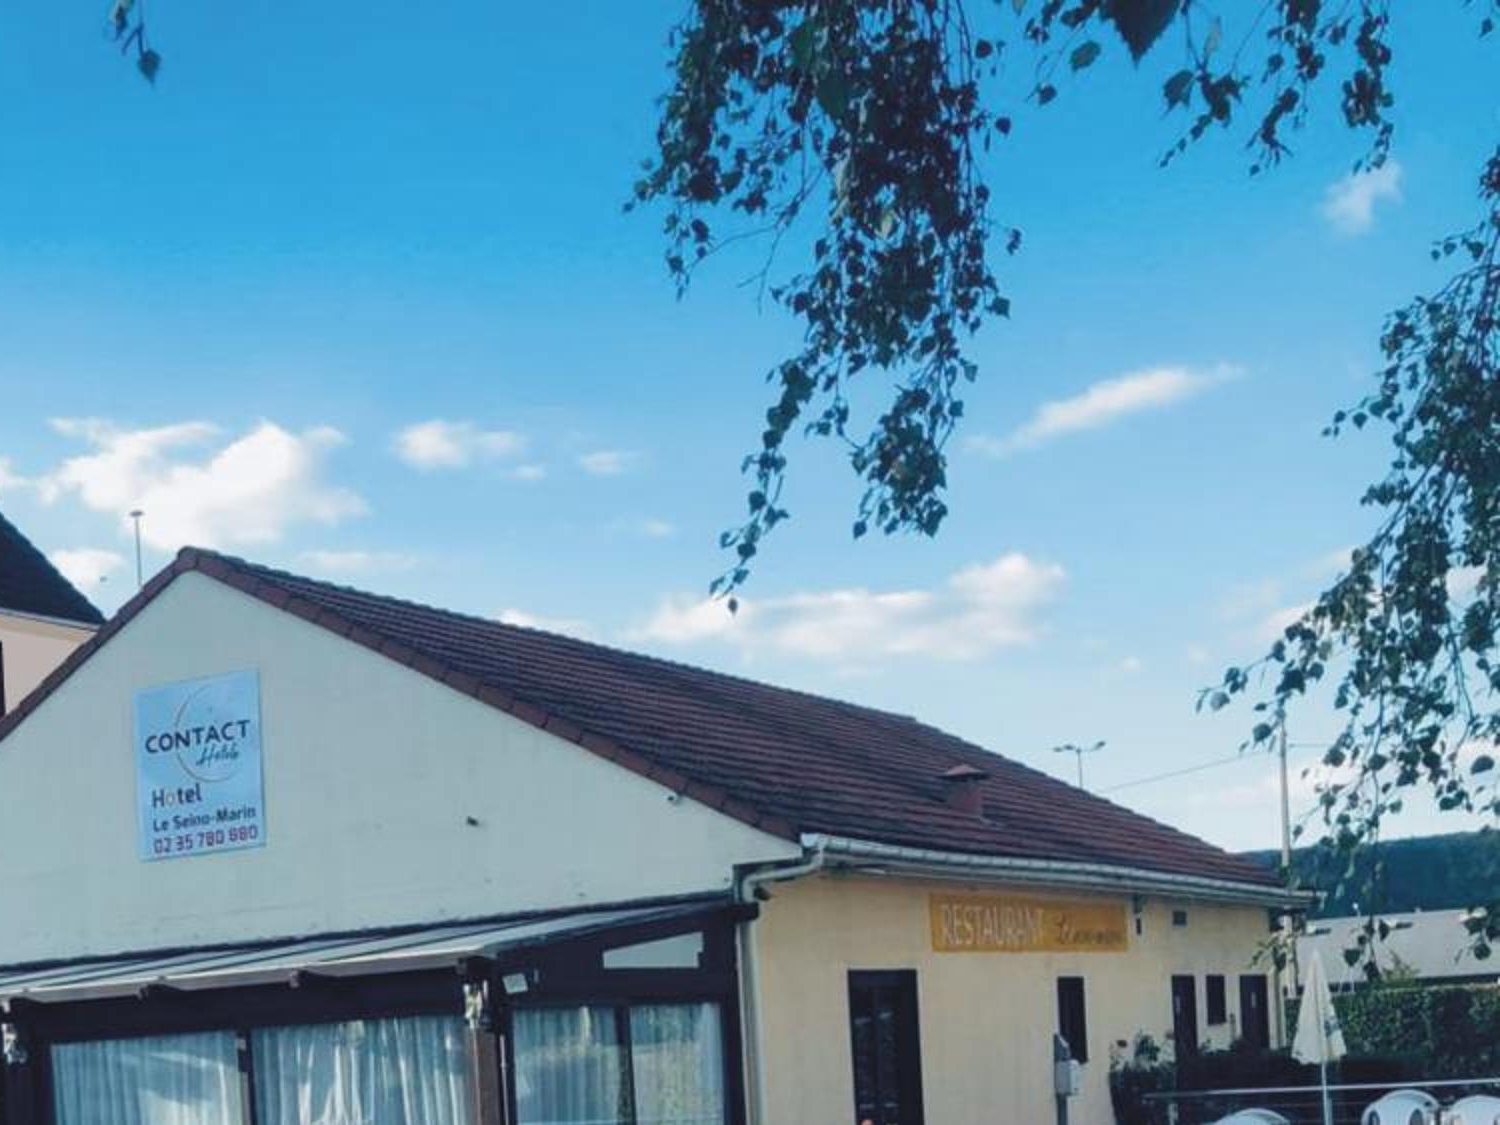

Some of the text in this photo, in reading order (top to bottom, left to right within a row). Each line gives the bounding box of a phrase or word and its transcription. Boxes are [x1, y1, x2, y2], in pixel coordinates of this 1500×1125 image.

[145, 719, 250, 754] CONTACT
[153, 806, 256, 833] Le Seino-Marin
[154, 837, 171, 855] 02
[176, 833, 193, 852] 35
[937, 904, 1044, 945] RESTAURANT
